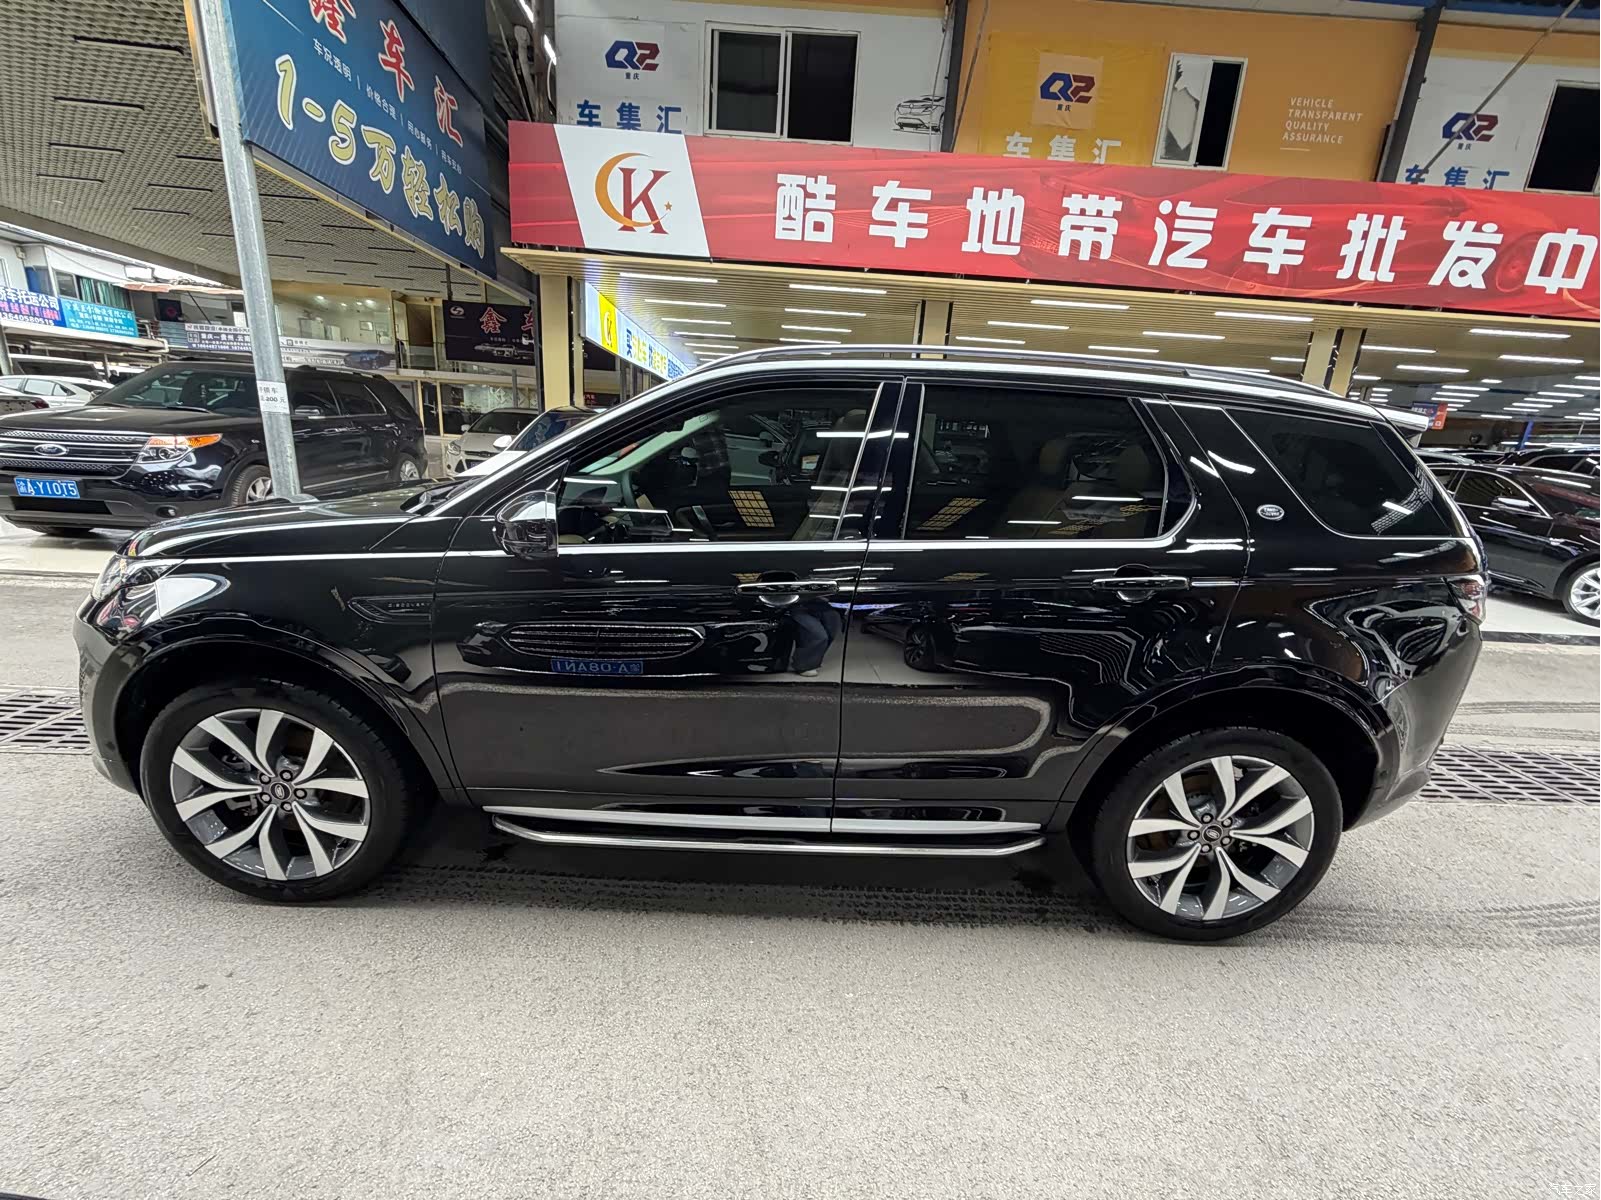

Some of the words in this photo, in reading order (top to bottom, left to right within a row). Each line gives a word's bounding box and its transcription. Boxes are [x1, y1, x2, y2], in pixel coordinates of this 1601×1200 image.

[313, 38, 352, 82] 车况透明
[625, 72, 640, 81] 重庆
[1290, 97, 1334, 109] VEHICLE
[577, 99, 682, 134] 车集汇
[1288, 109, 1363, 122] TRANSPARENT
[1285, 120, 1330, 132] QUALITY
[1282, 131, 1344, 144] ASSURANCE
[275, 54, 485, 259] 1-5万轻松购
[774, 173, 1599, 294] 酷车地带汽车批发中
